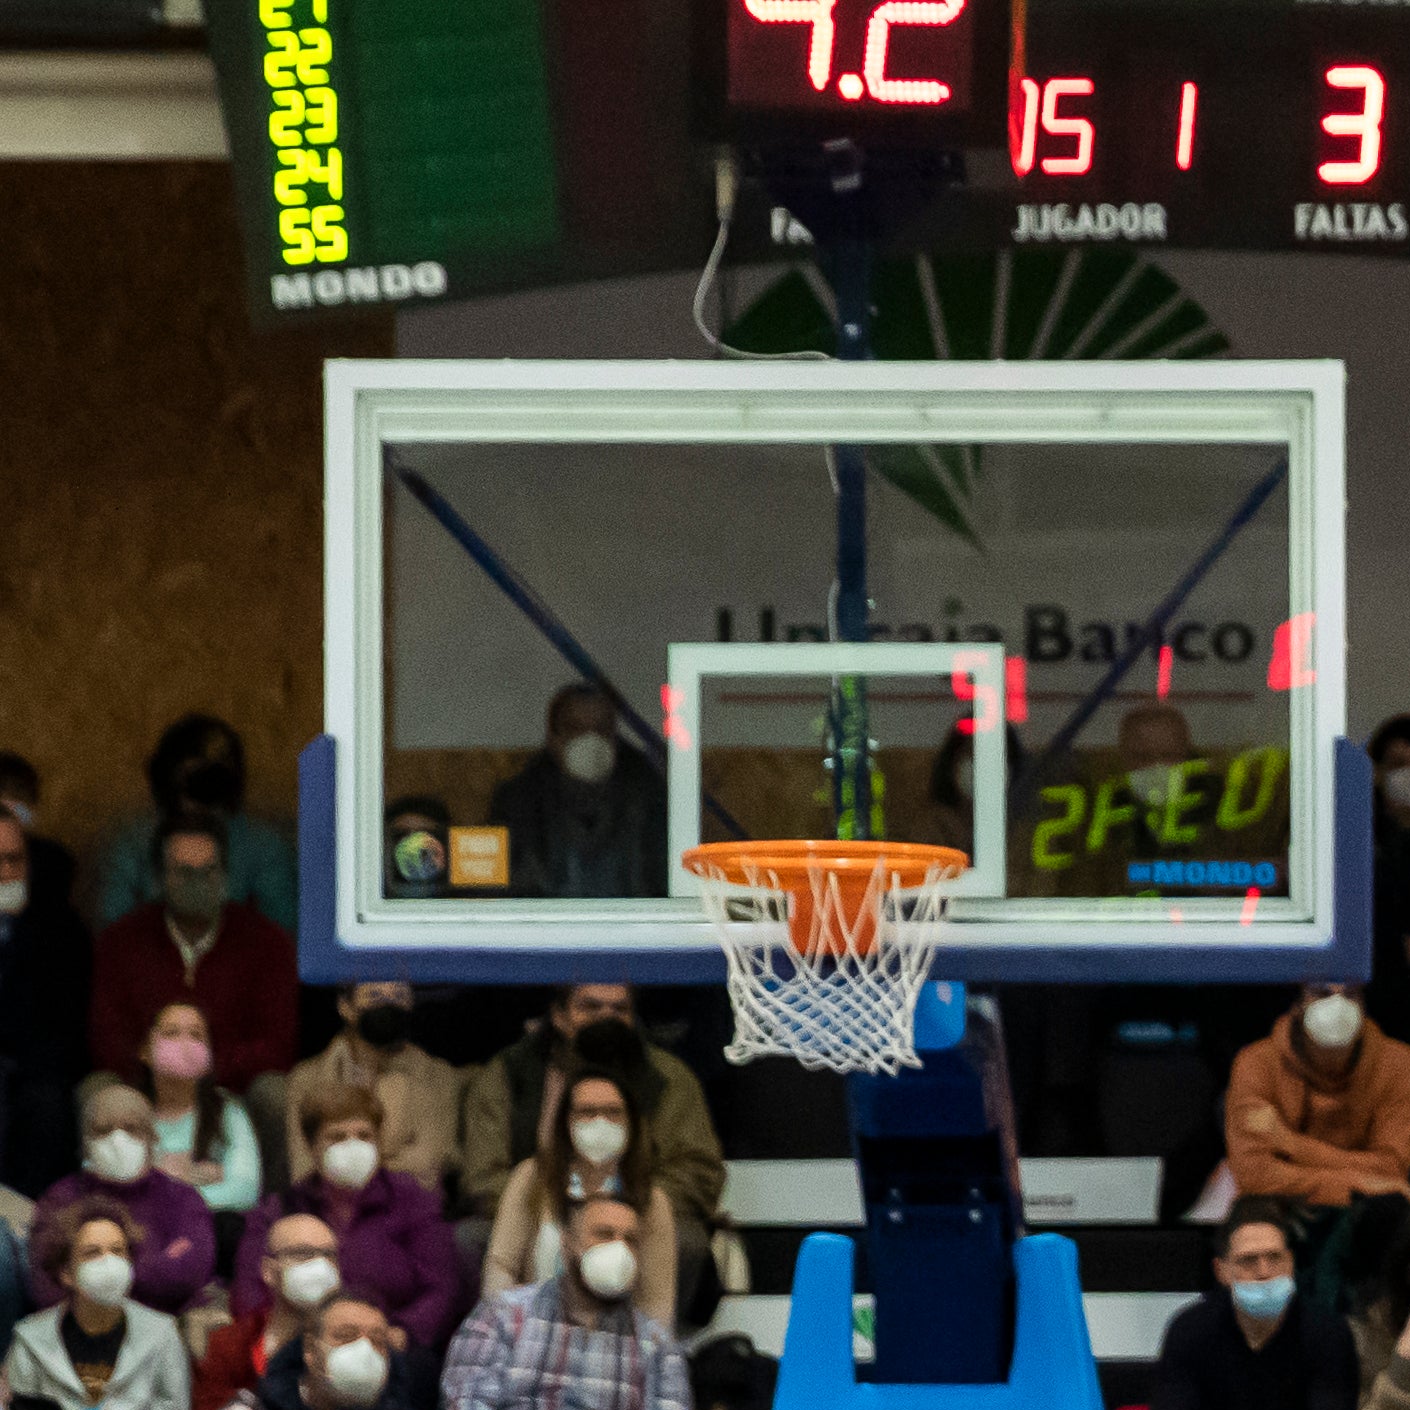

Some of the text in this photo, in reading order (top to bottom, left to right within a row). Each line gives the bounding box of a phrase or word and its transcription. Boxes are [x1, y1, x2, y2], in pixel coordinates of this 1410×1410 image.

[1316, 65, 1385, 184] 3
[1011, 202, 1168, 243] JUGADOR
[1295, 203, 1409, 242] FALTAS
[270, 262, 447, 309] MONDO
[1153, 860, 1277, 886] MONDO
